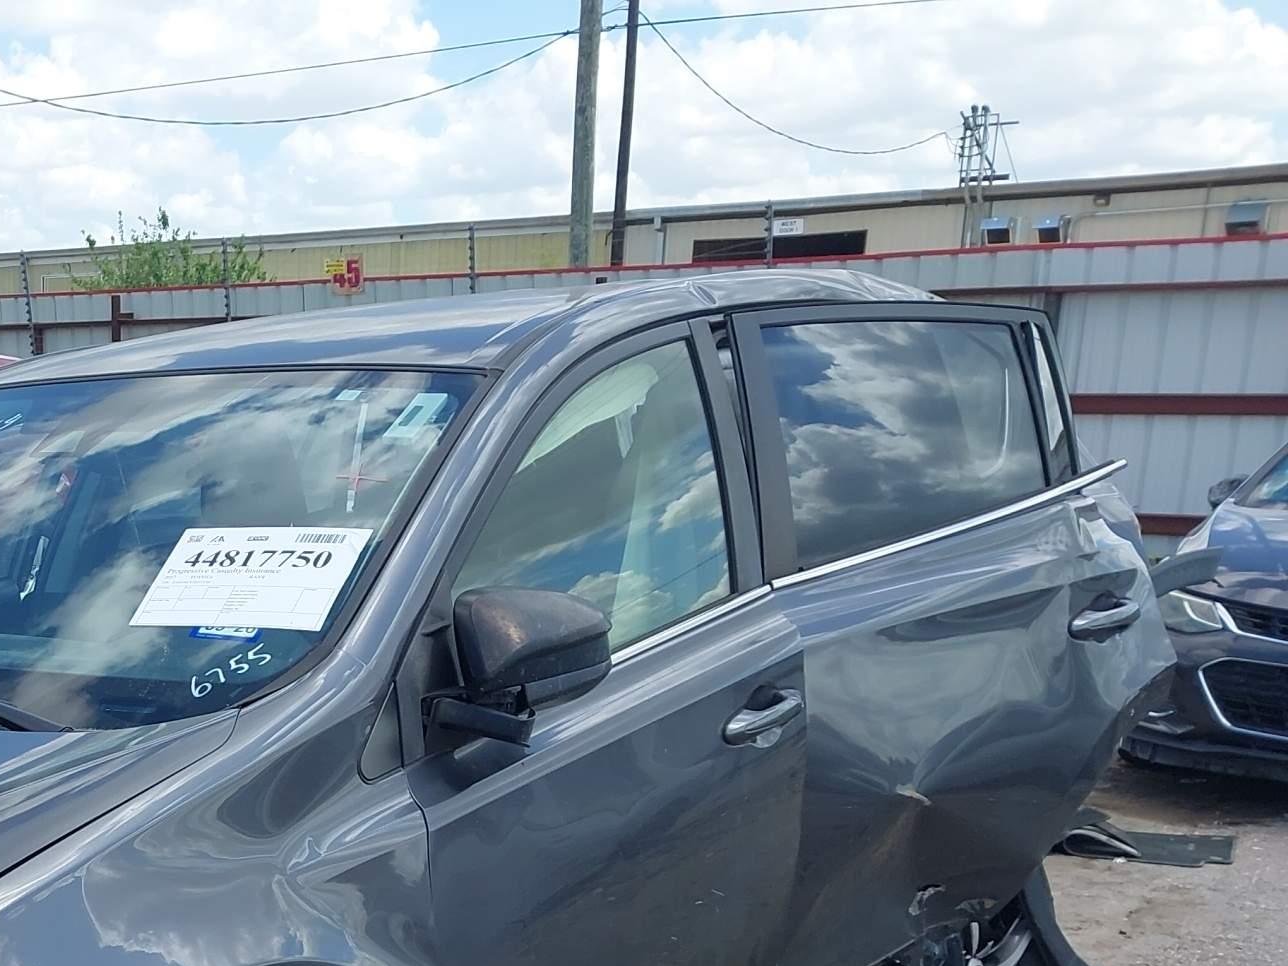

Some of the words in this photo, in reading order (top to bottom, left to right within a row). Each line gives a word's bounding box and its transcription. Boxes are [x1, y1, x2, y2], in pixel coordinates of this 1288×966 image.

[333, 259, 360, 288] 45
[184, 549, 333, 569] 44817750
[190, 643, 272, 698] 6755
